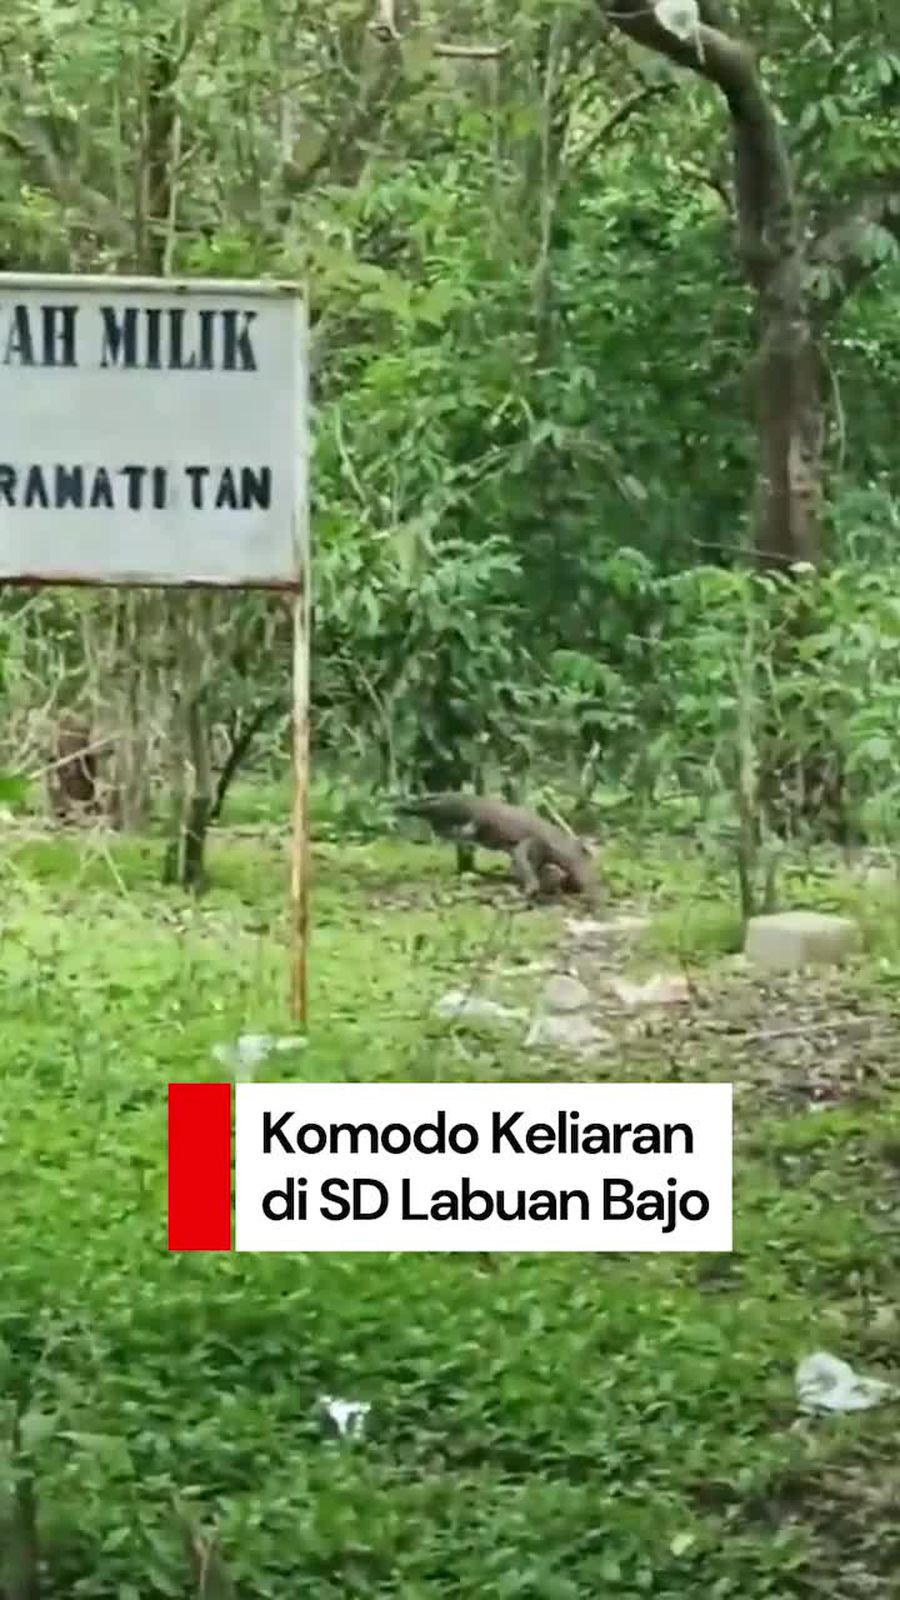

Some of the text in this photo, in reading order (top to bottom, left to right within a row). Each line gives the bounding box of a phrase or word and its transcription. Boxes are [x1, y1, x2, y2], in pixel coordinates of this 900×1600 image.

[0, 304, 258, 372] AH MILIK
[184, 466, 272, 510] TAN
